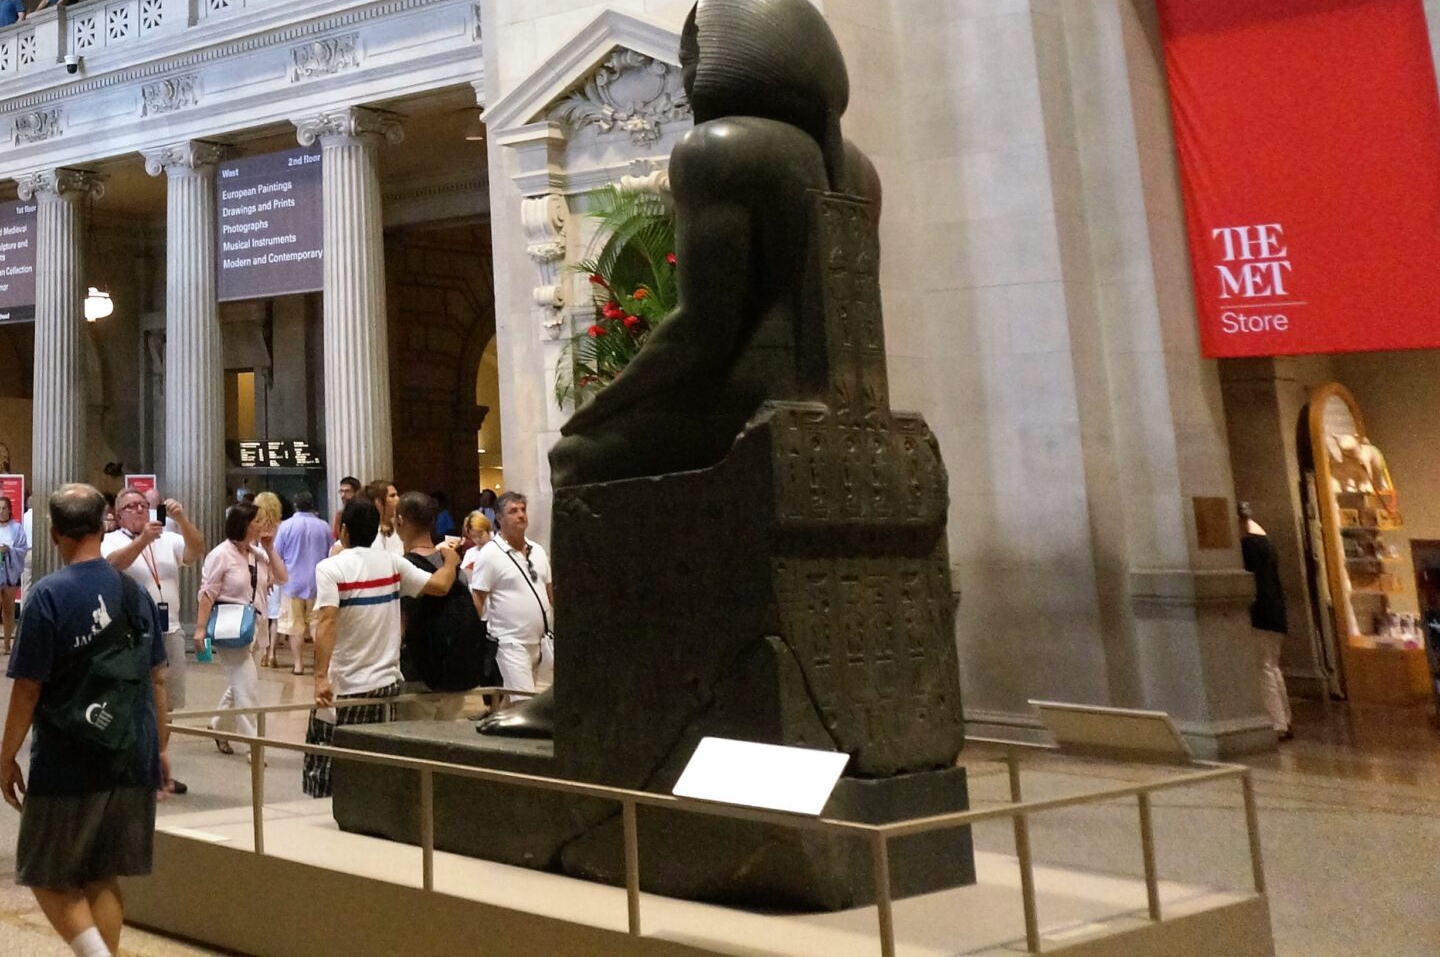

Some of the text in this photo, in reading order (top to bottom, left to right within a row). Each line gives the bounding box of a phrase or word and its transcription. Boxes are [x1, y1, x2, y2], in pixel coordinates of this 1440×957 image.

[288, 155, 321, 166] 2nd floor
[222, 169, 239, 178] West
[222, 181, 292, 200] European Paintings
[222, 198, 295, 217] Drawings and Prints
[3, 225, 28, 235] Medieval
[222, 220, 268, 234] Photographs
[17, 239, 28, 248] and
[223, 234, 296, 251] Musical Instruments
[1211, 223, 1287, 261] THE
[223, 249, 323, 269] Modern and Contemporary
[6, 266, 32, 275] Collection
[1213, 261, 1292, 298] MET
[1221, 311, 1289, 333] Store
